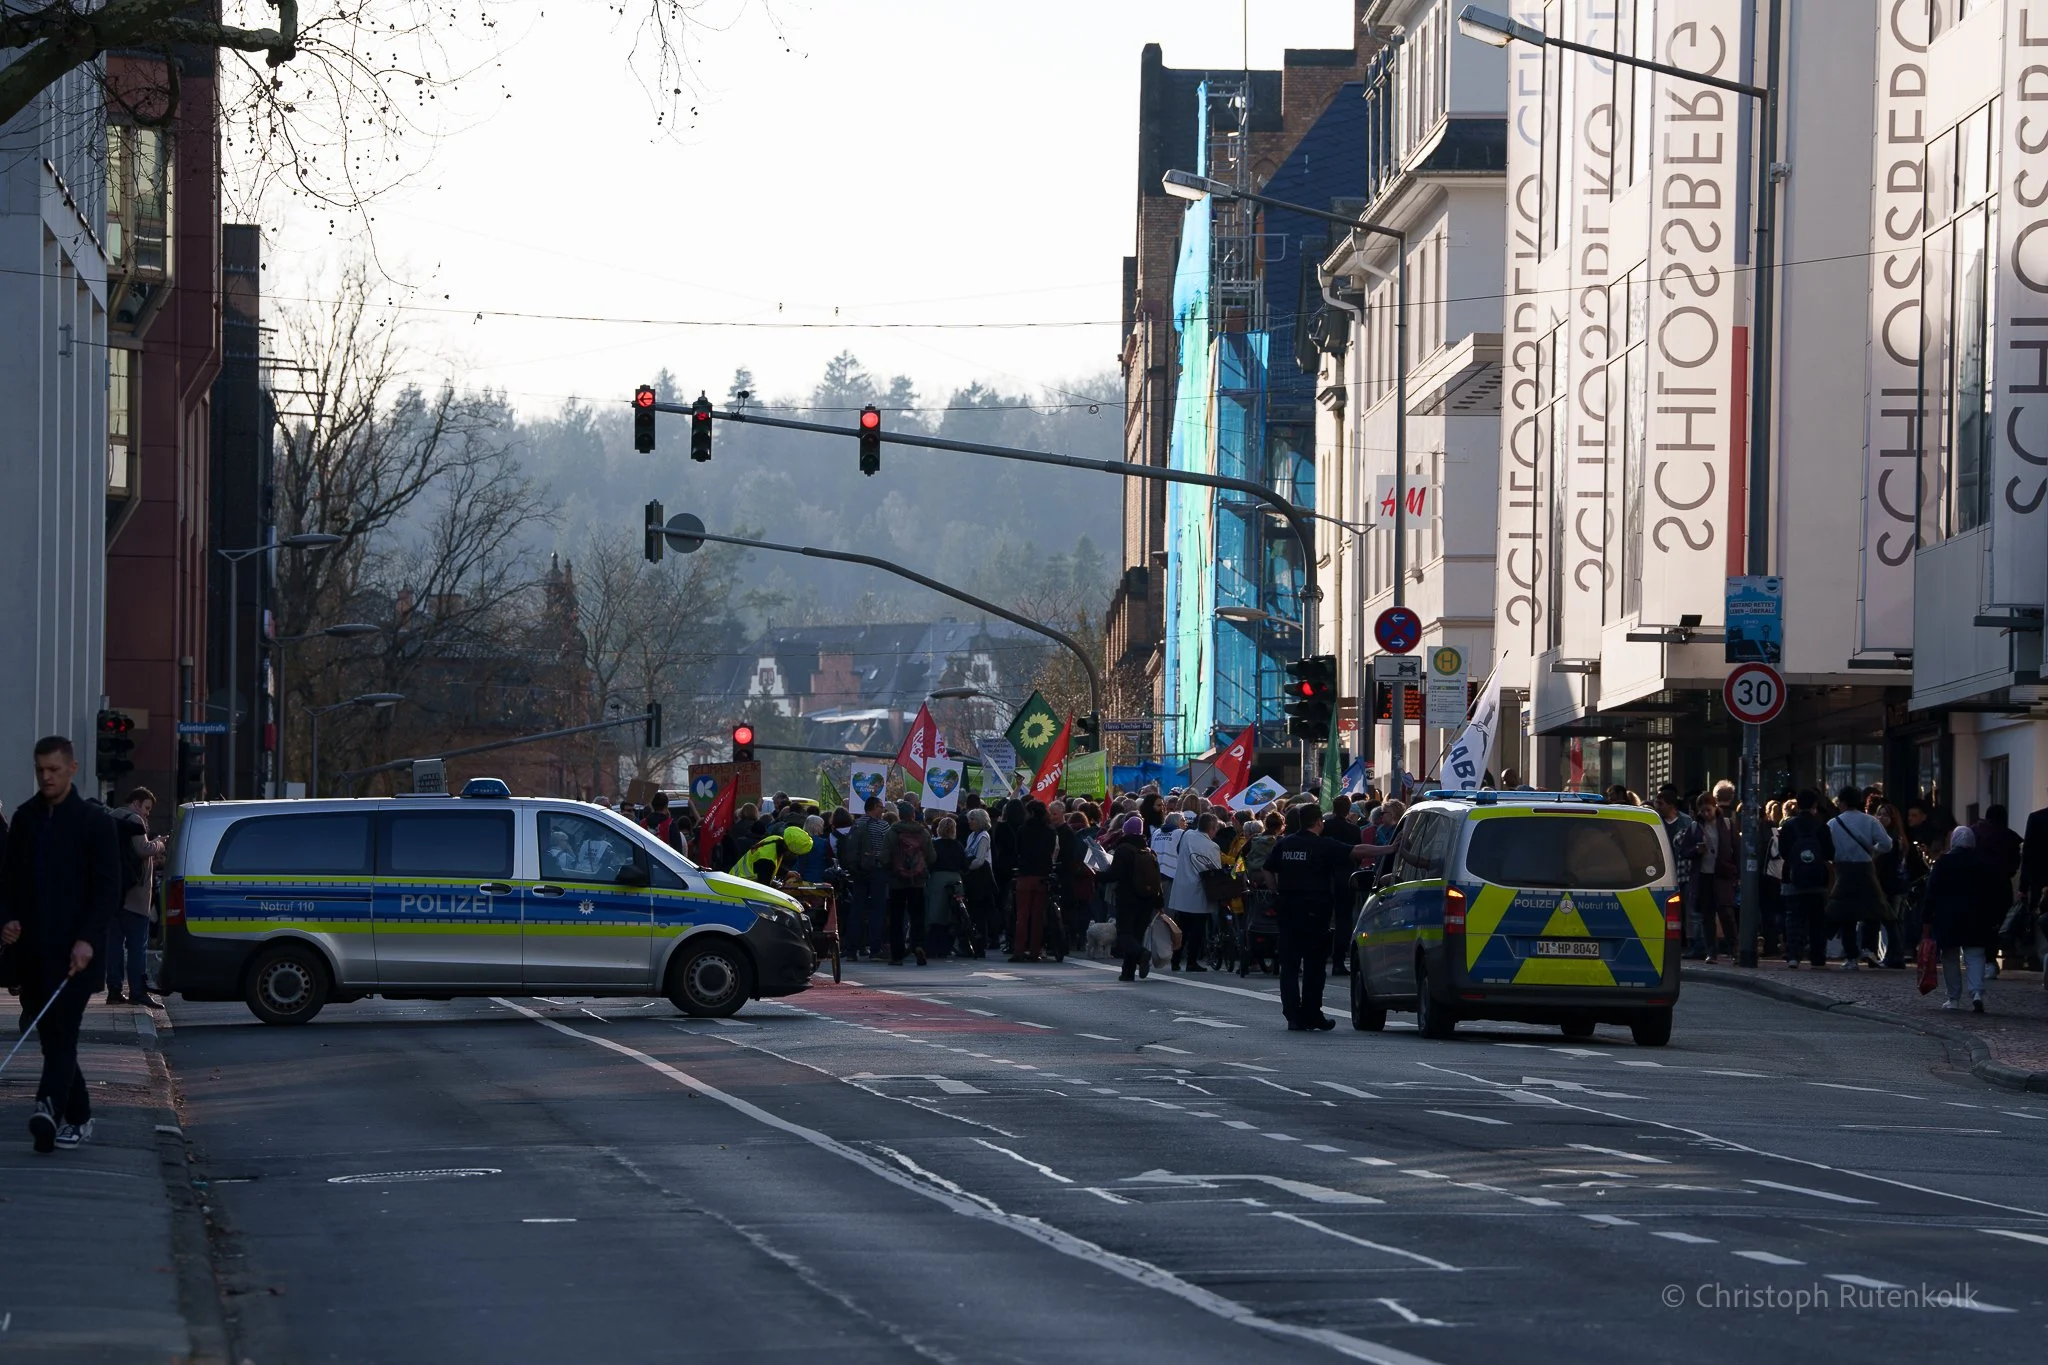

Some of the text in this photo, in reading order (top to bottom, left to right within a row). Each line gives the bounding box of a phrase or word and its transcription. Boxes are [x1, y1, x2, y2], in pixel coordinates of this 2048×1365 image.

[1380, 486, 1427, 517] HM
[1441, 653, 1453, 669] H
[1738, 679, 1772, 707] 30
[179, 724, 225, 733] Gutenbergstraße
[1450, 738, 1476, 790] ABU
[1282, 851, 1307, 861] POLIZEI
[260, 901, 315, 912] Notruf 110
[400, 894, 494, 913] POLIZEI
[1514, 898, 1556, 909] POLIZEI
[1577, 901, 1619, 911] Notruf 110
[1538, 942, 1598, 954] WI HP 8042
